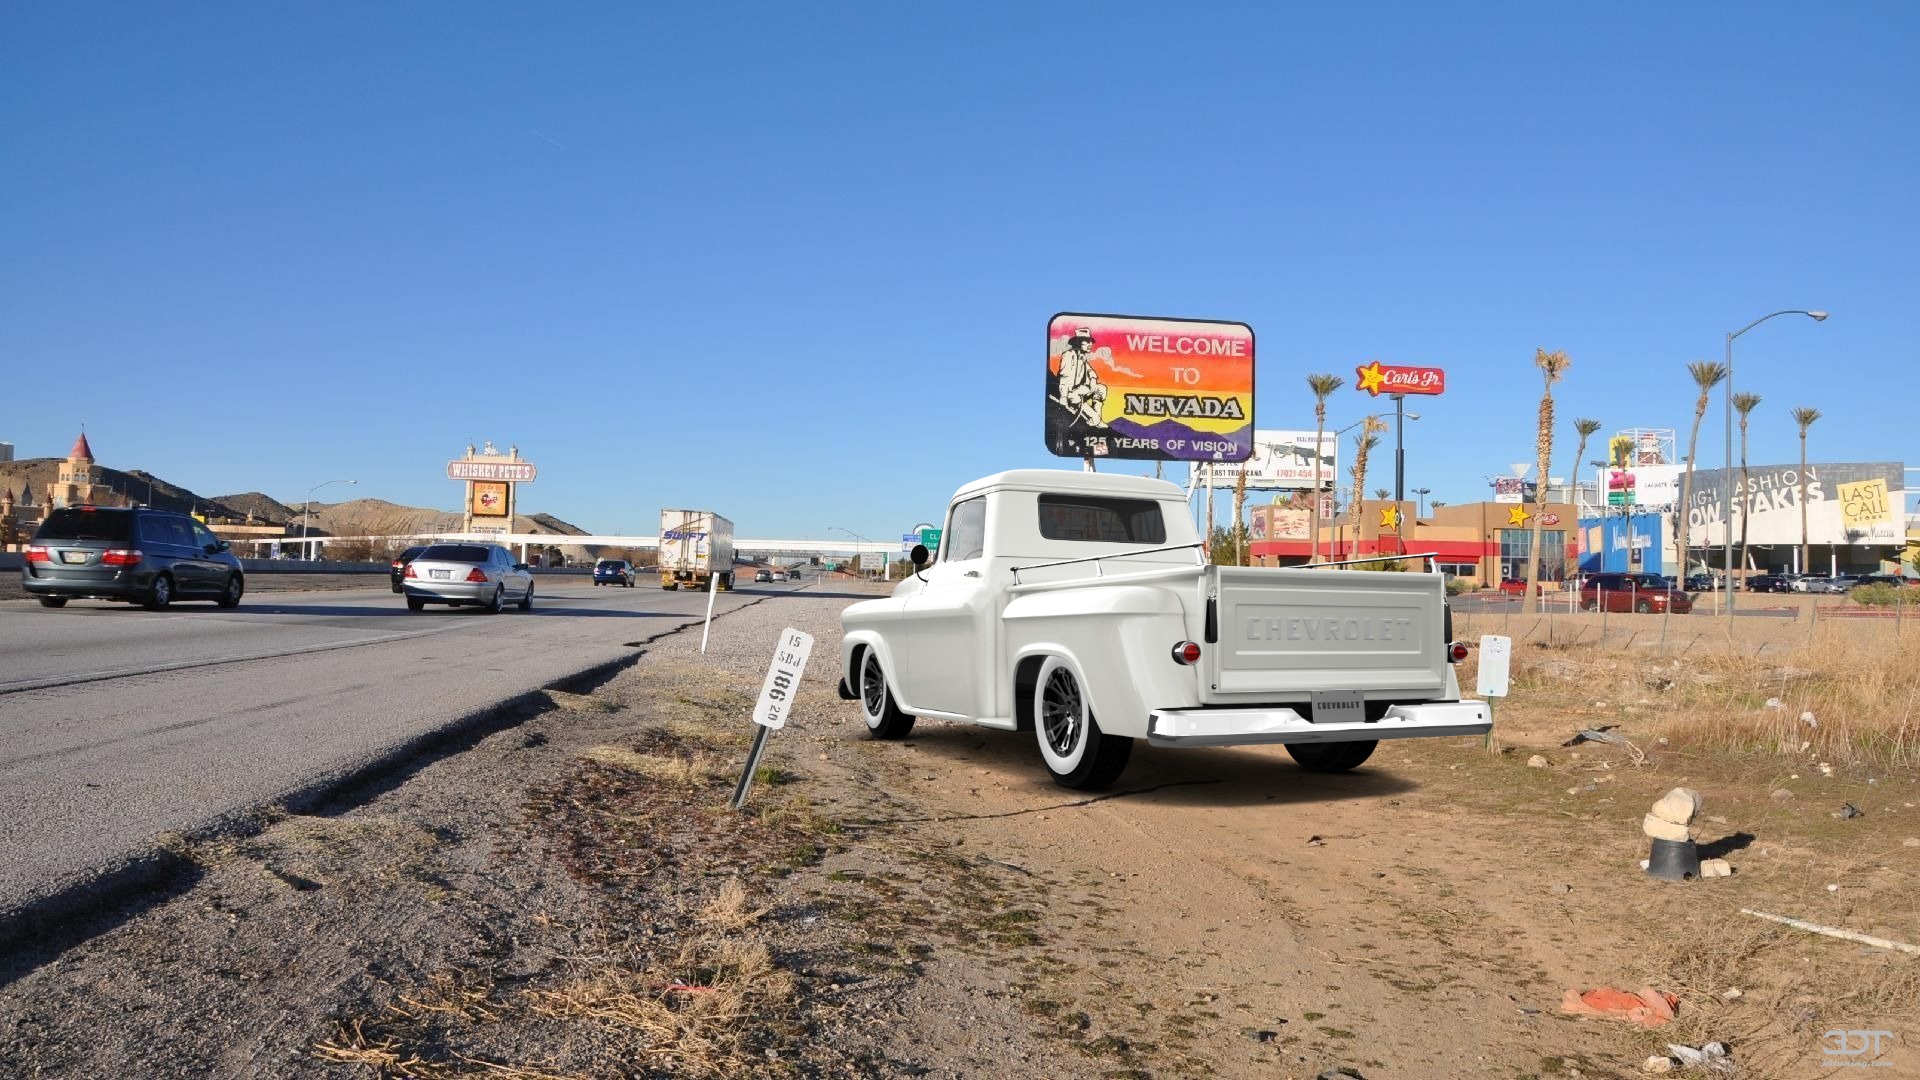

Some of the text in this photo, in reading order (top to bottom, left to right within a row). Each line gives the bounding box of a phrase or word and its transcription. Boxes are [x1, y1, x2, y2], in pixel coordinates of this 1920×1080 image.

[1126, 335, 1245, 357] WELCOME
[1170, 367, 1200, 385] TO
[1383, 370, 1442, 387] Carl's Jr.
[1125, 393, 1244, 420] NEVADA
[1084, 436, 1238, 452] 125 YEARS OF VISION
[453, 463, 530, 479] WHISKEY PETE'S
[1842, 484, 1882, 503] LAST
[1844, 500, 1888, 517] CALL
[1247, 616, 1411, 642] CHEVROLET
[789, 635, 802, 648] 15
[769, 669, 794, 702] 186
[1318, 701, 1360, 710] CHEVROLET
